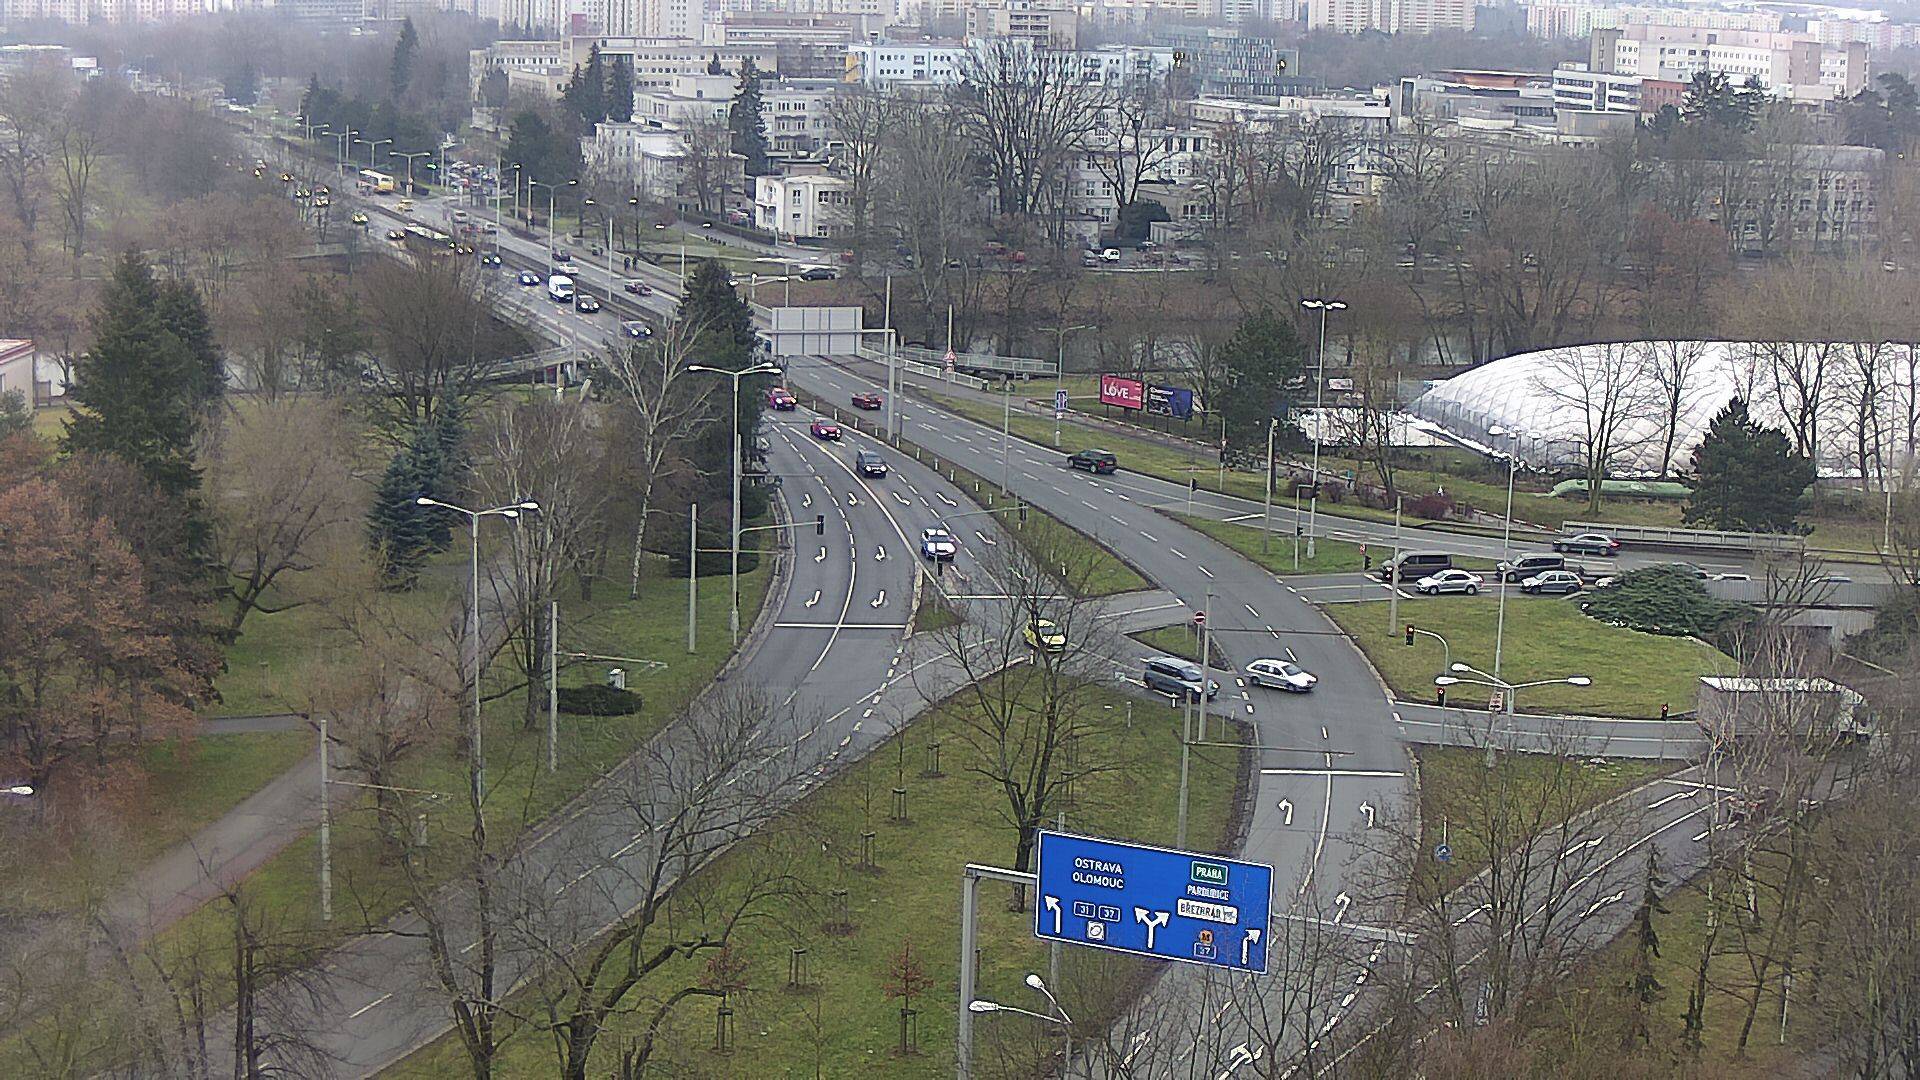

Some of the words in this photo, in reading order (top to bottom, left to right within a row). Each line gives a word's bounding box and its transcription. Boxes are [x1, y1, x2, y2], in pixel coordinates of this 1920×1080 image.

[1104, 383, 1129, 399] LOVE
[1074, 857, 1123, 875] OSTRAVA
[1196, 866, 1223, 880] PRAHA
[1072, 871, 1124, 889] OLOMOUC
[1080, 905, 1089, 915] 31
[1104, 909, 1115, 918] 37
[1199, 946, 1211, 955] 37
